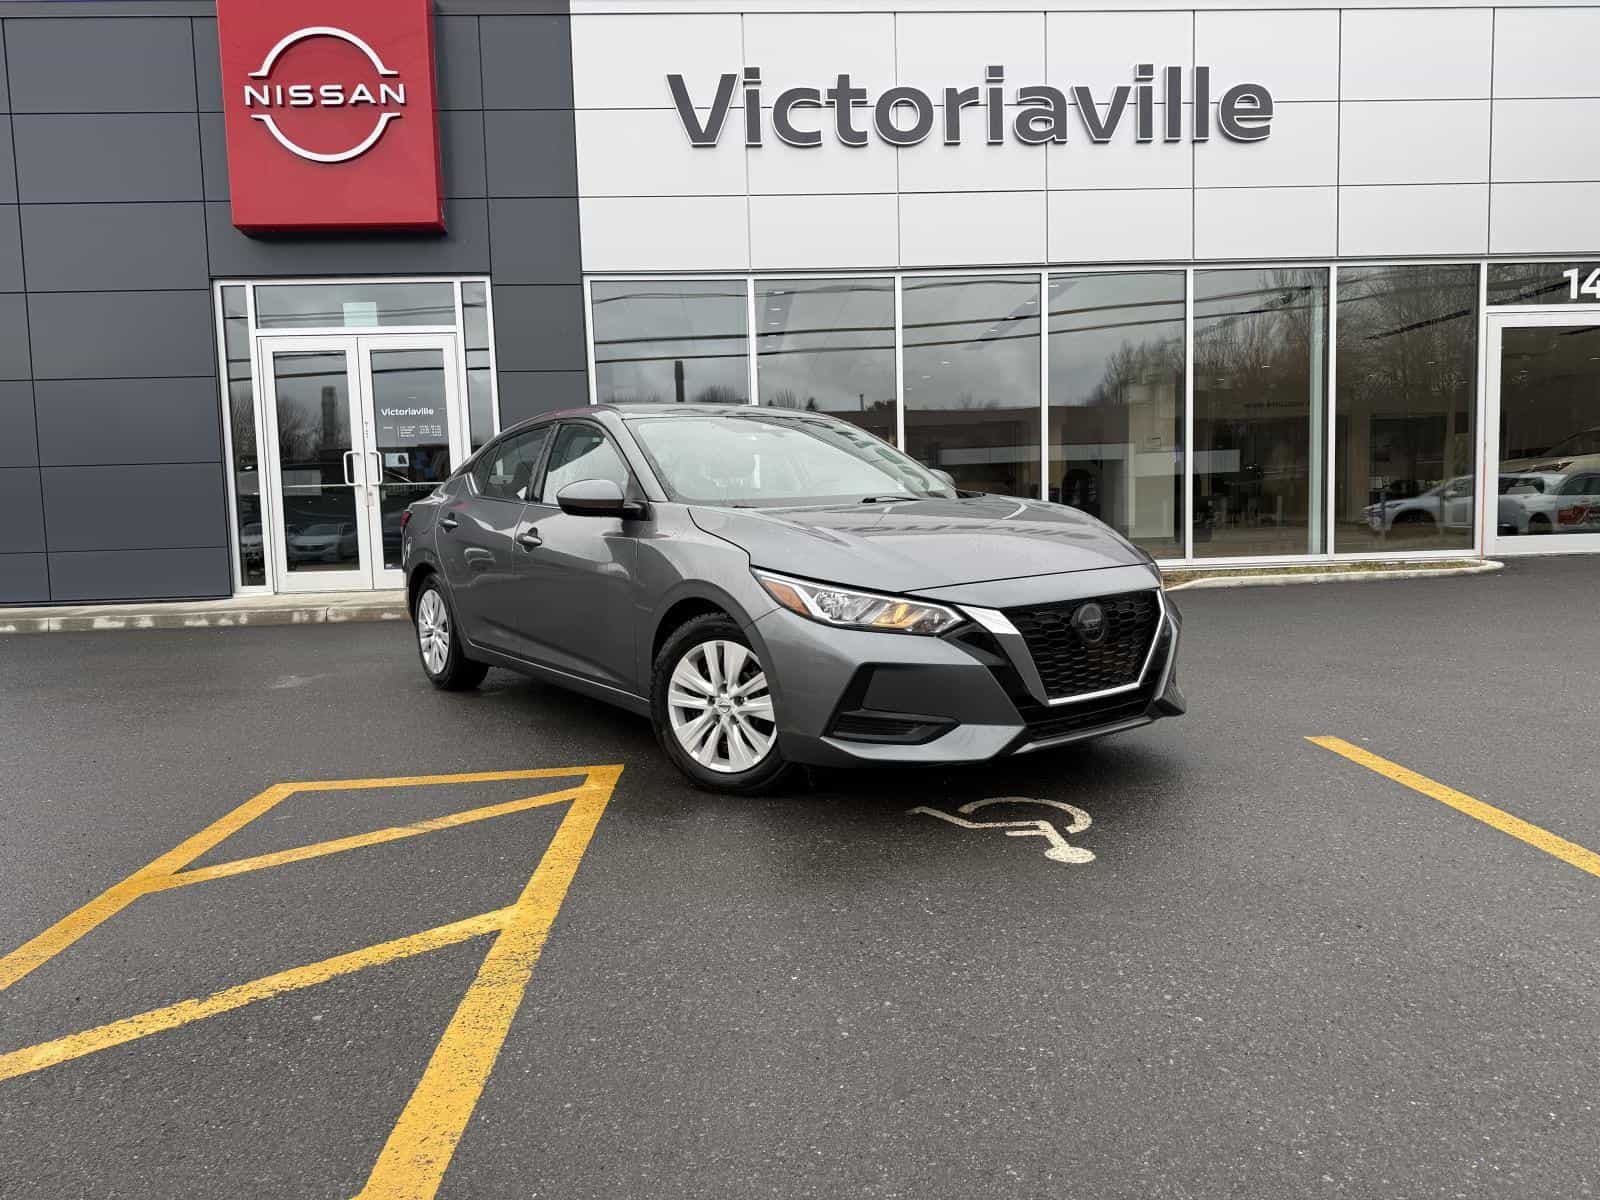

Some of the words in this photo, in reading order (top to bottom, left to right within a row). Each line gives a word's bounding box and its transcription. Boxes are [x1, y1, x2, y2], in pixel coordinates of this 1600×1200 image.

[243, 83, 406, 106] NISSAN
[667, 64, 1275, 147] Victoriaville
[380, 407, 434, 416] Victoriaville
